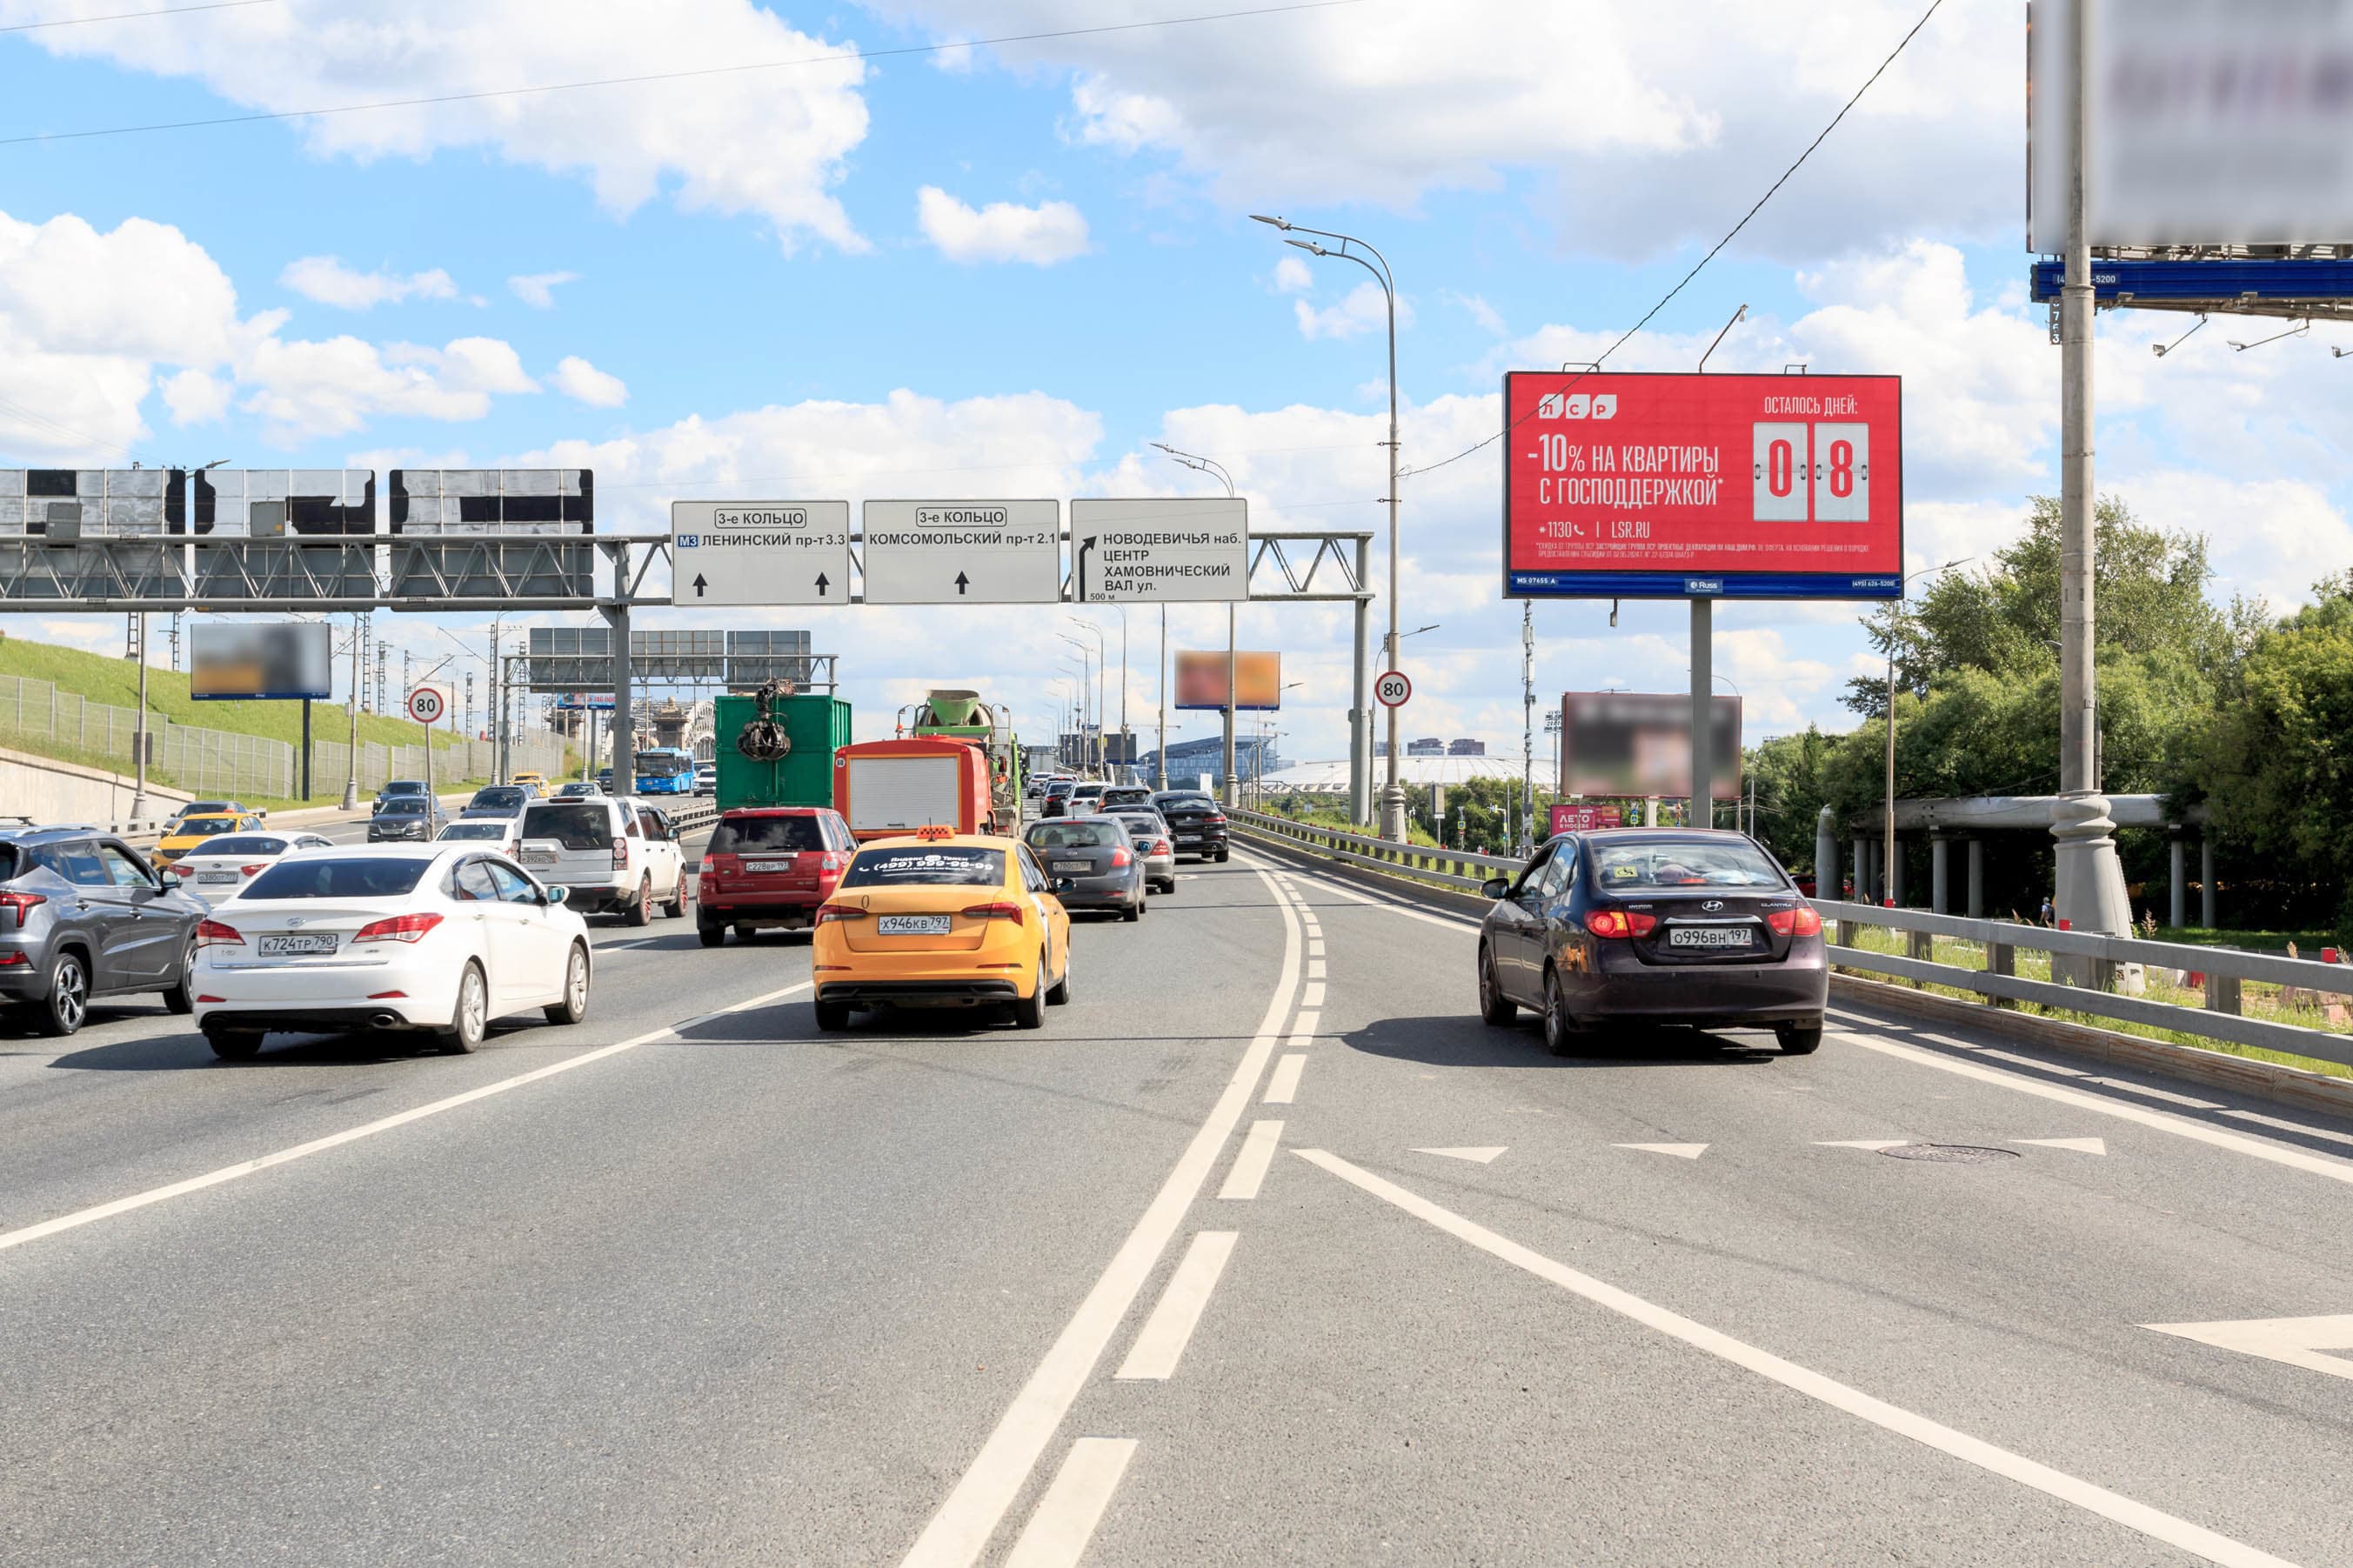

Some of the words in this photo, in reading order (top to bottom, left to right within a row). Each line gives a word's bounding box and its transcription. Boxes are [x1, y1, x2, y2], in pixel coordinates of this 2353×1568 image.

[1540, 399, 1611, 418] ЛСР
[1764, 397, 1820, 415] ОСТАЛОСЬ
[1823, 394, 1858, 417] ДНЕЙ:
[1528, 434, 1585, 471] -10%
[1593, 445, 1614, 472] НА
[1623, 445, 1719, 472] КВАРТИРЫ
[1540, 478, 1550, 504] С
[719, 513, 739, 524] 3-е
[743, 512, 804, 526] КОЛЬЦО
[919, 511, 939, 524] 3-е
[944, 511, 1004, 525] КОЛЬЦО
[1612, 522, 1650, 538] LSR.RU
[678, 536, 698, 546] М3
[702, 532, 792, 546] ЛЕНИНСКИЙ
[795, 536, 825, 549] пр-т
[826, 534, 846, 545] 3.3
[869, 530, 1002, 545] КОМСОМОЛЬСКИЙ
[1006, 534, 1035, 547] пр-т
[1037, 533, 1055, 544] 2.1
[1103, 532, 1210, 547] НОВОДЕВИЧЬЯ
[1213, 532, 1241, 544] наб.
[1103, 550, 1150, 563] ЦЕНТР
[1104, 565, 1230, 577] ХАМОВНИЧЕСКИЙ
[1105, 579, 1133, 591] ВАЛ
[1137, 581, 1156, 594] ул.
[1090, 592, 1106, 601] 500
[1384, 682, 1404, 697] 80
[417, 698, 436, 712] 80
[882, 918, 927, 929] Х946КВ
[930, 917, 948, 926] 797
[264, 937, 313, 951] К724ТР
[314, 936, 333, 945] 790
[1674, 931, 1726, 944] О996ВН
[1729, 930, 1748, 940] 197
